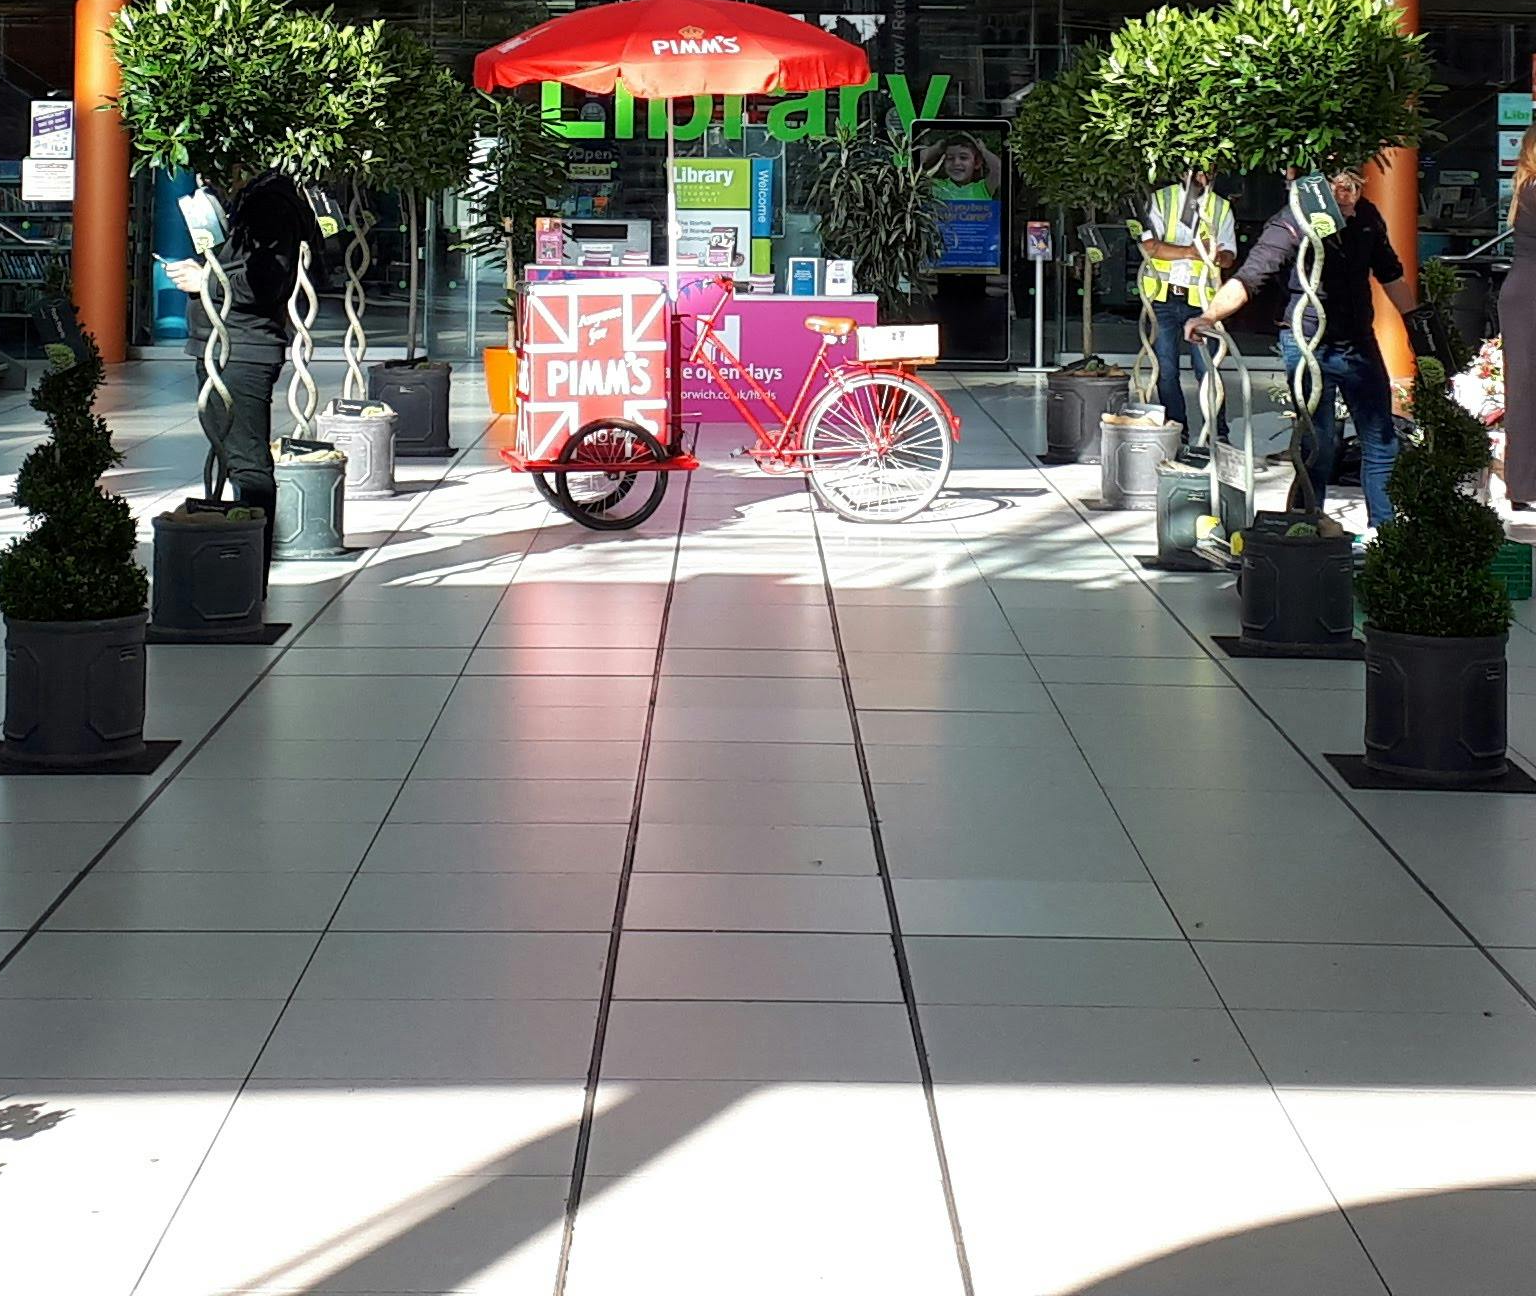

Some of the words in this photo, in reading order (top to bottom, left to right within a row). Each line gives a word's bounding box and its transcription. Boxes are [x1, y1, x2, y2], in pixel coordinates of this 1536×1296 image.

[651, 35, 741, 56] PIMM'S
[894, 50, 905, 72] row
[540, 74, 951, 141] Library
[571, 147, 613, 162] Open
[673, 167, 734, 186] Library
[758, 170, 770, 223] Welcome
[547, 352, 651, 397] PIMM'S
[696, 366, 739, 383] open
[745, 362, 782, 383] days
